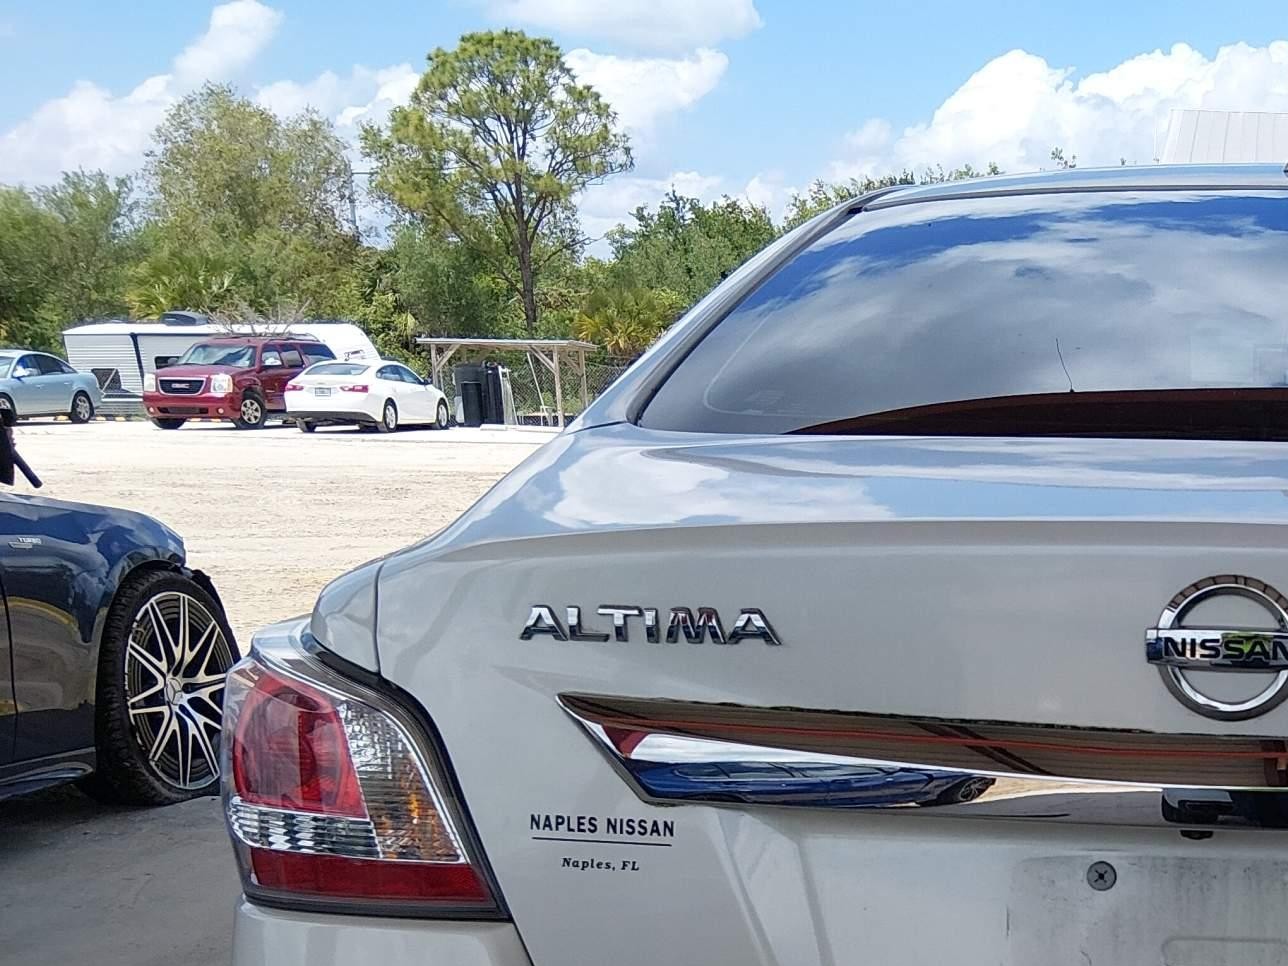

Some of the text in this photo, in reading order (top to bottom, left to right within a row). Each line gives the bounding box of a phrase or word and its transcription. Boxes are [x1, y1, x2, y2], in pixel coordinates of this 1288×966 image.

[519, 604, 782, 646] ALTIMA
[530, 813, 675, 837] NAPLES NISSAN
[561, 857, 640, 871] Naples, FL
